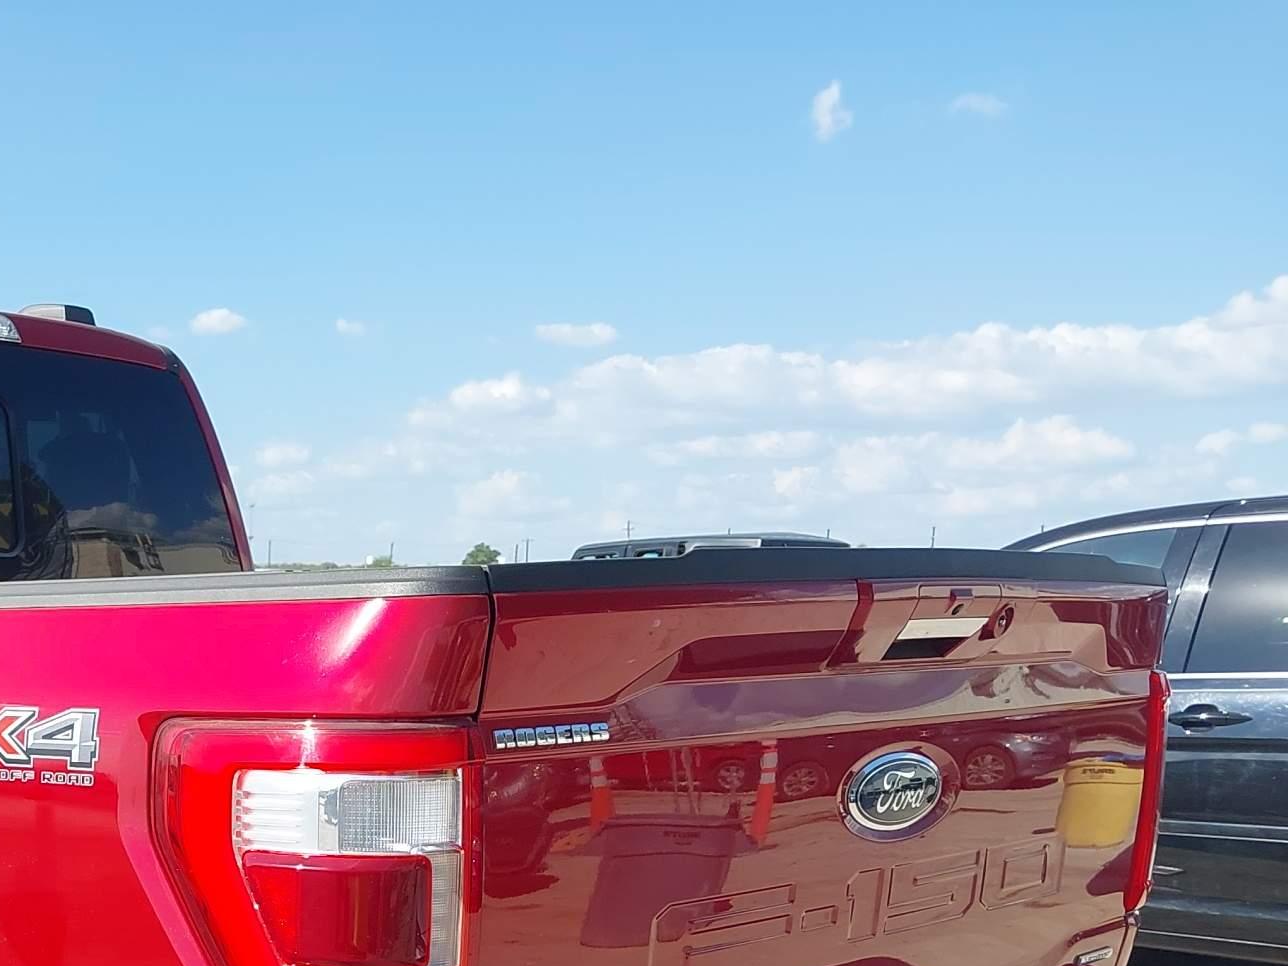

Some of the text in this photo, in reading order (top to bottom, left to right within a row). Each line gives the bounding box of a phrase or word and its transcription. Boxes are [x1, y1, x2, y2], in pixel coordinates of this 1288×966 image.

[493, 722, 611, 750] ROGERS
[40, 771, 95, 787] ROAD
[876, 770, 925, 814] Ford
